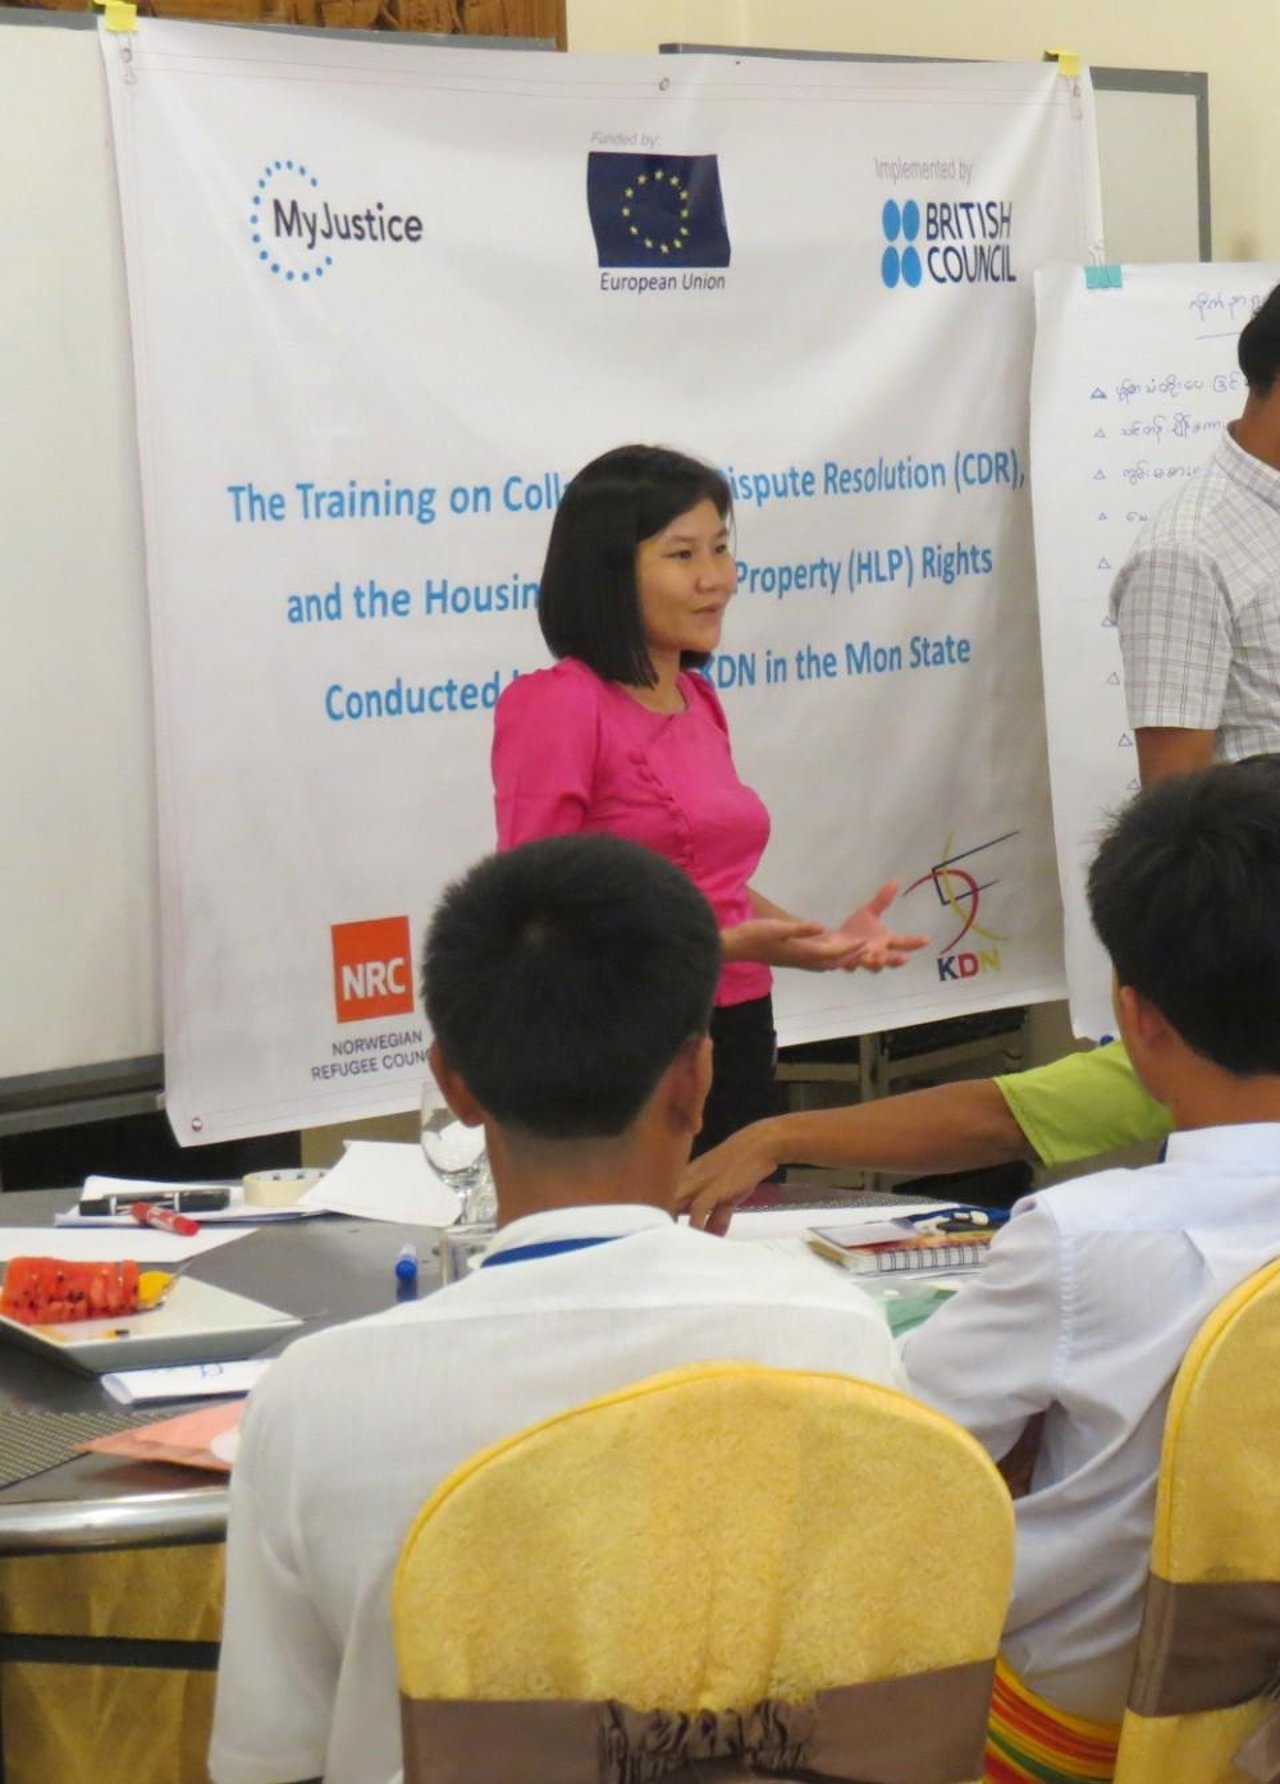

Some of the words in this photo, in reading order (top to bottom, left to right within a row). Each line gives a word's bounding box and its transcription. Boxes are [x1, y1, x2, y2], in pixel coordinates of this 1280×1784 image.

[590, 131, 638, 146] Funded
[875, 156, 955, 185] Implemented
[273, 198, 423, 249] MyJustice
[926, 201, 1012, 240] BRITISH
[600, 272, 677, 293] European
[682, 272, 725, 290] Union
[927, 245, 1017, 283] COUNCIL
[228, 482, 286, 522] The
[296, 479, 436, 525] Training
[449, 485, 491, 515] on
[718, 465, 816, 507] ispute
[824, 456, 946, 495] Resolution
[953, 448, 1025, 494] (CDR),
[287, 582, 341, 623] and
[353, 580, 410, 619] the
[425, 573, 542, 616] Housin
[734, 557, 841, 599] Property
[848, 545, 914, 592] (HLP)
[922, 542, 992, 585] Rights
[325, 669, 500, 721] Conducted
[766, 650, 788, 684] in
[796, 645, 838, 681] the
[844, 641, 903, 675] Mon
[908, 634, 971, 668] State
[341, 956, 406, 1002] NRC
[937, 948, 1003, 982] KDN
[331, 1029, 423, 1057] NORWEGIAN
[310, 1057, 379, 1081] REFUGEE
